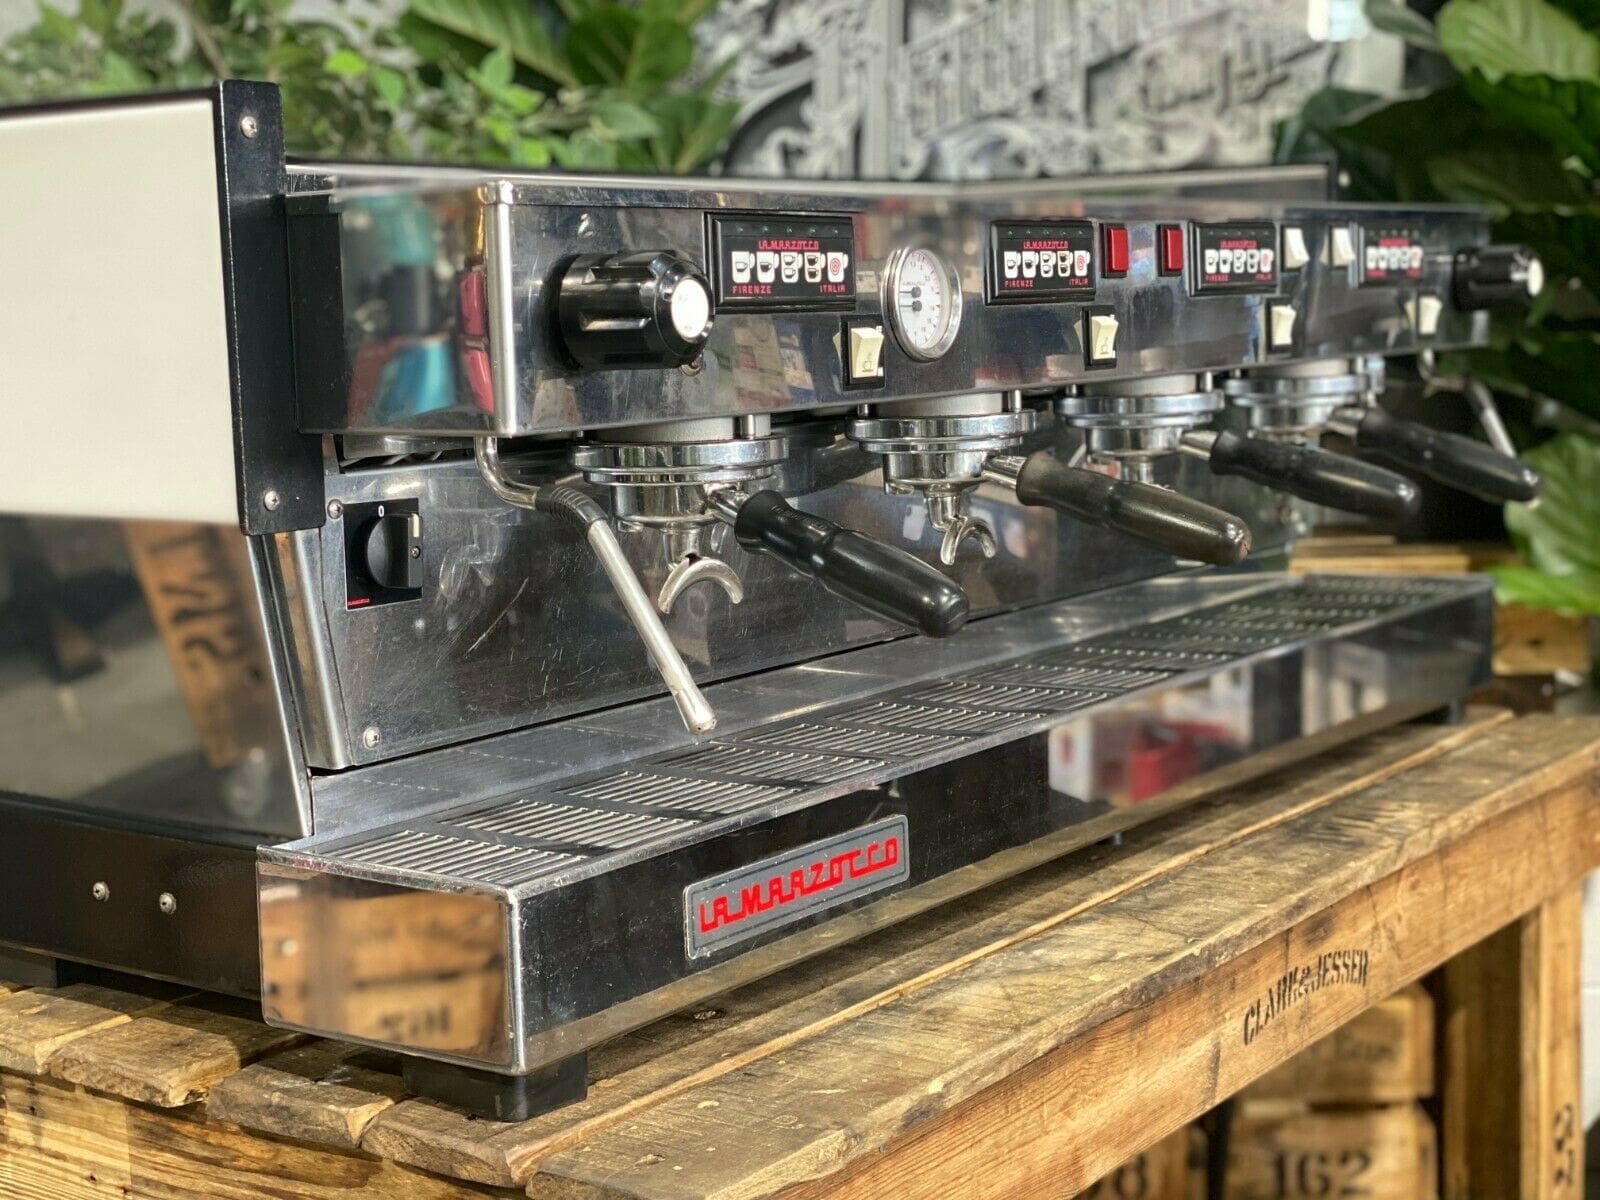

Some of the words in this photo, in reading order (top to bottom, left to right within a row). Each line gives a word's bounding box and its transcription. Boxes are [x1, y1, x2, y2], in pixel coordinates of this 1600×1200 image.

[820, 284, 846, 293] ITALIA
[1005, 280, 1034, 288] FIRENZE
[732, 285, 772, 294] FIRENZE
[742, 838, 898, 914] MARZOCCO
